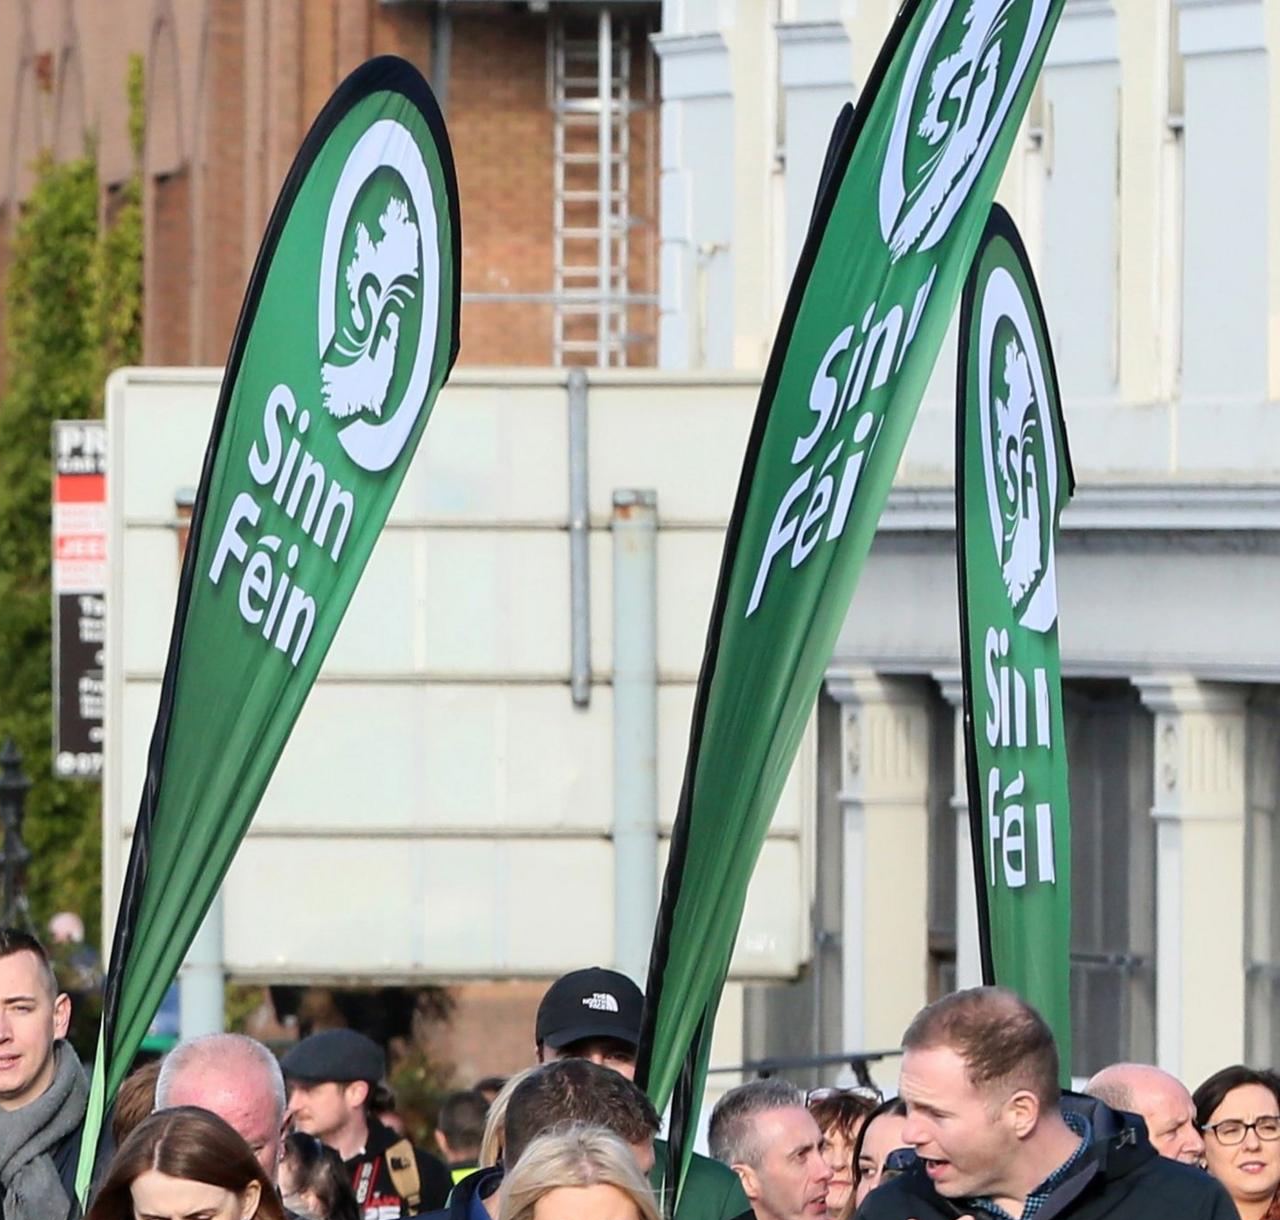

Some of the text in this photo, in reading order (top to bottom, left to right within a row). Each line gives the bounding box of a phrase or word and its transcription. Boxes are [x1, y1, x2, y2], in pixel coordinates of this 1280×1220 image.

[248, 383, 354, 562] Sinn
[745, 410, 884, 618] Féi
[209, 492, 317, 666] Féin
[988, 767, 1055, 889] Fé
